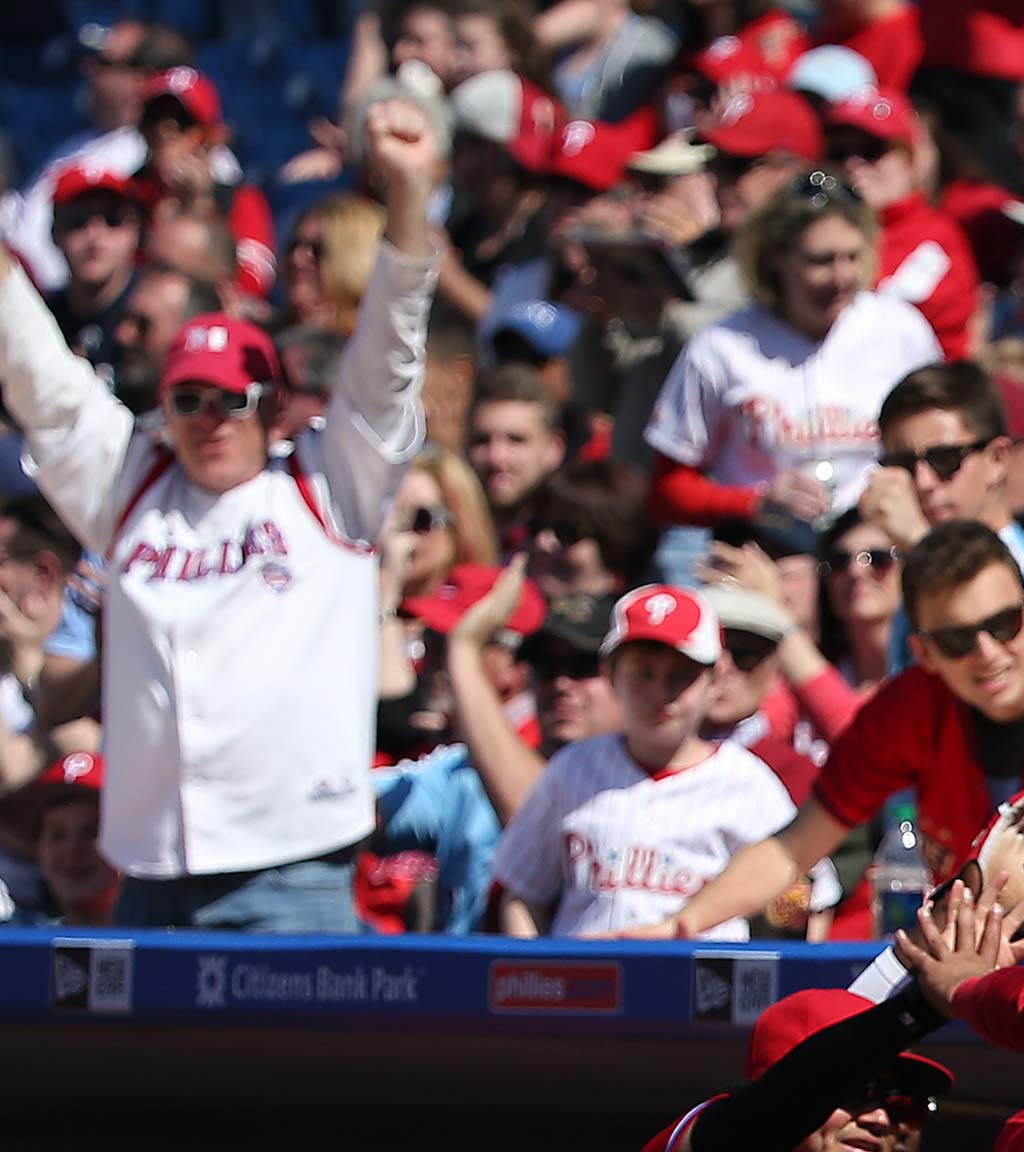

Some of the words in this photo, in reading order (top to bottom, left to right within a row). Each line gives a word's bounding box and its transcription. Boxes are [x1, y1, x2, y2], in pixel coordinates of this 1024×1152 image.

[231, 964, 313, 998] Citizens
[316, 965, 368, 999] Bank
[371, 965, 418, 1001] Park
